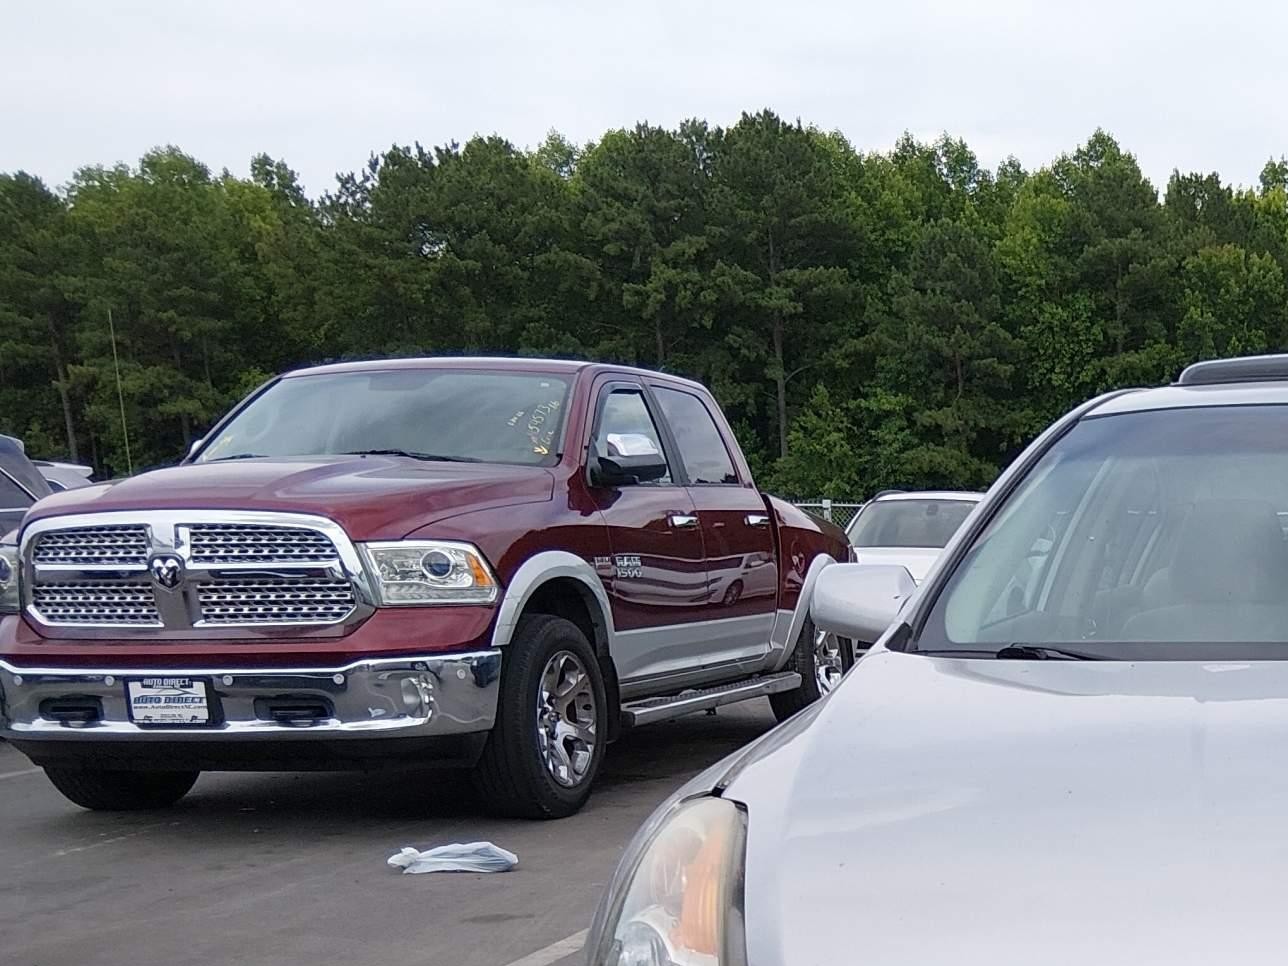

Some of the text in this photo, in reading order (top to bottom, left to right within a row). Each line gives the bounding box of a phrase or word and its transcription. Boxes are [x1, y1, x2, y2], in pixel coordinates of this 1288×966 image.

[616, 568, 642, 578] 1500
[133, 696, 204, 704] AUTO DIRECT
